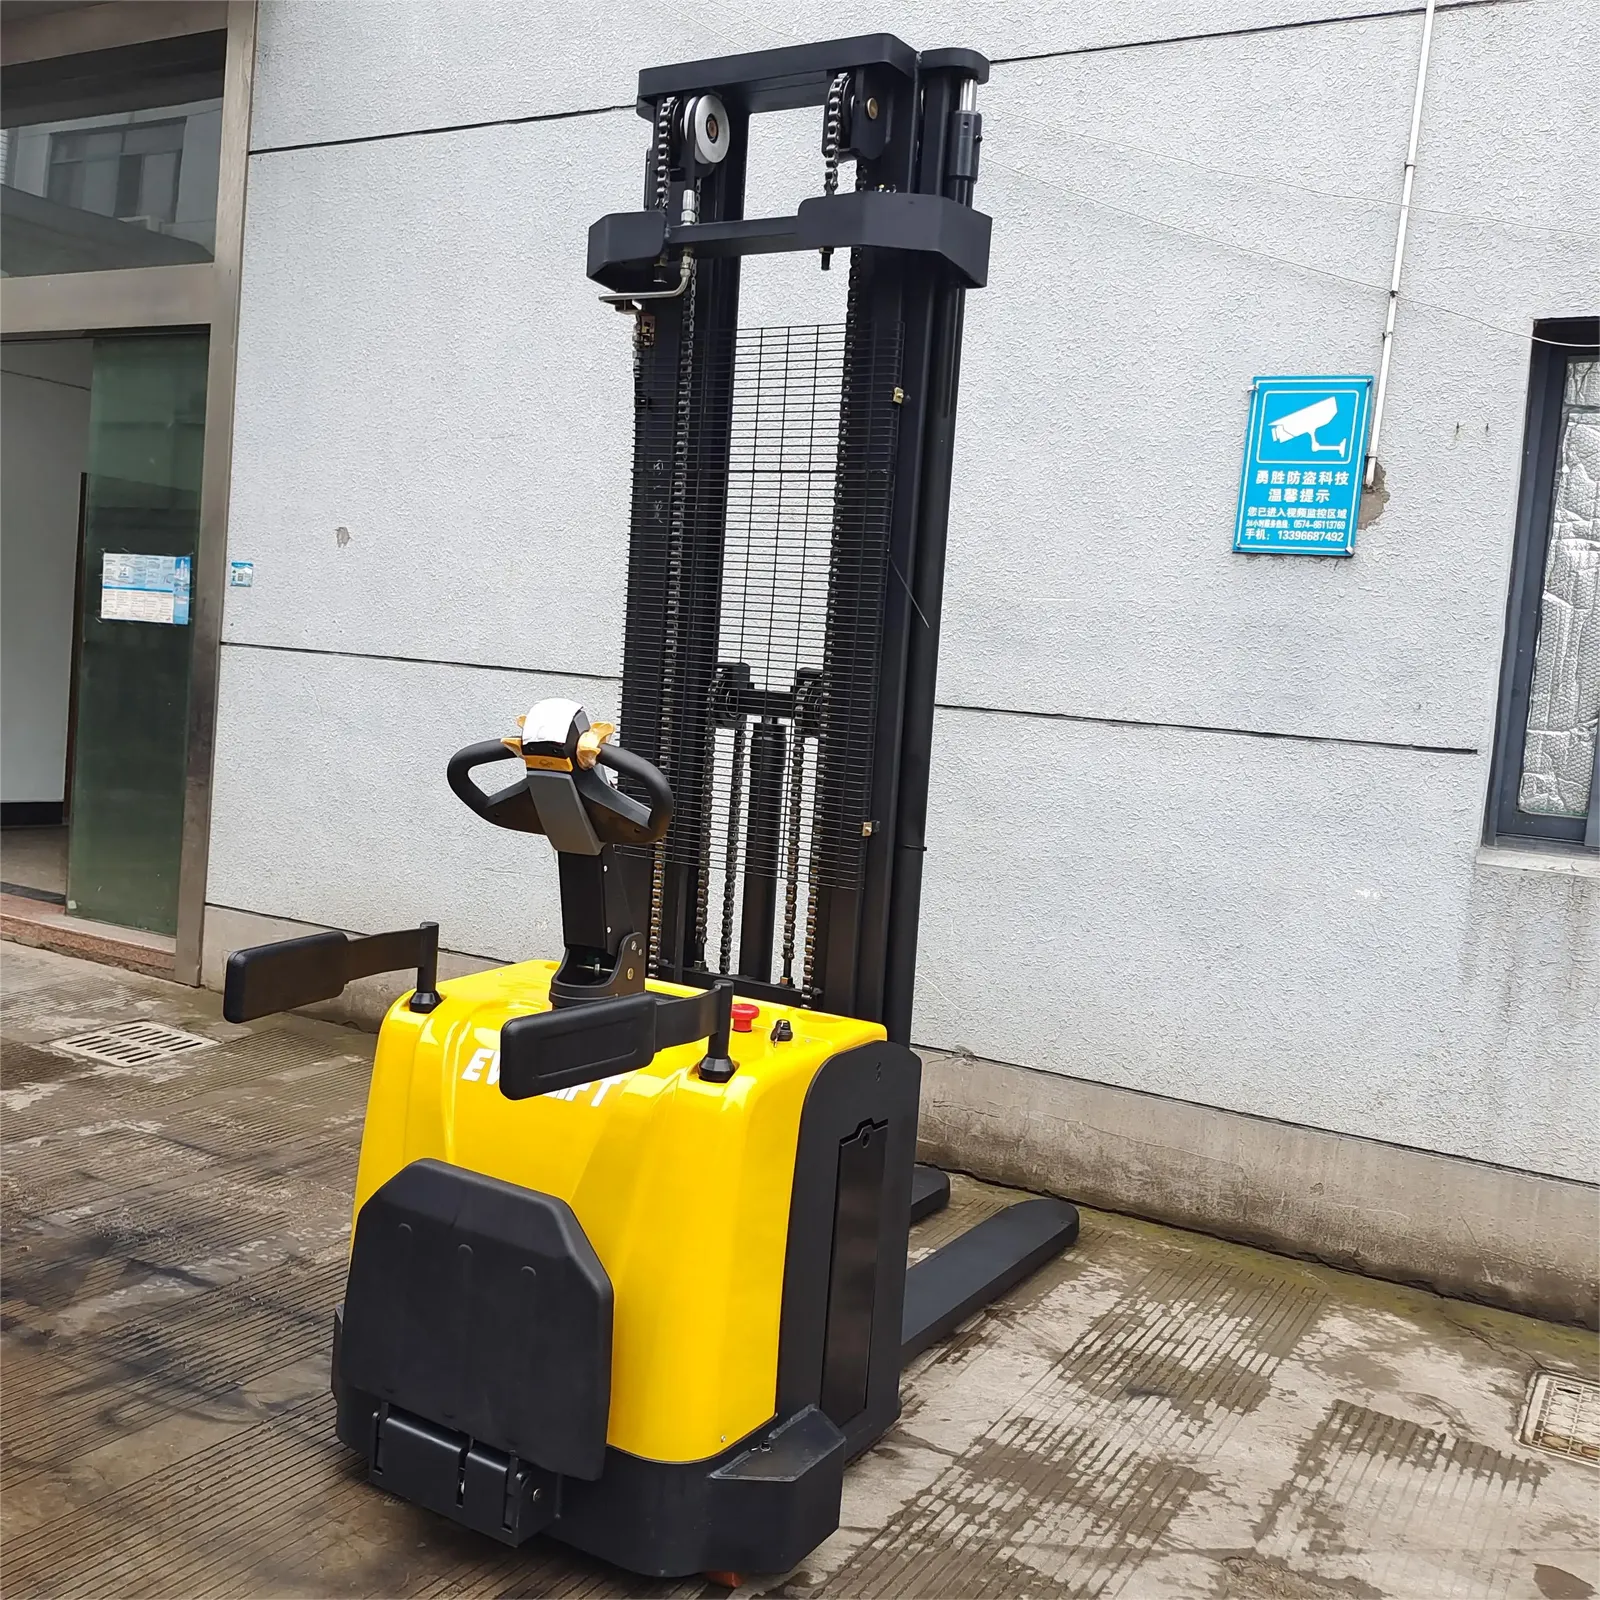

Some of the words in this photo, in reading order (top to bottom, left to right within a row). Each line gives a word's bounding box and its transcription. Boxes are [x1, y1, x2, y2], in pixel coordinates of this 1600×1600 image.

[1255, 470, 1350, 486] 勇胜防盗科技
[1268, 488, 1331, 503] 温馨提示
[1247, 506, 1348, 519] 您已进入视频监控区域
[1277, 530, 1345, 542] 13396687492
